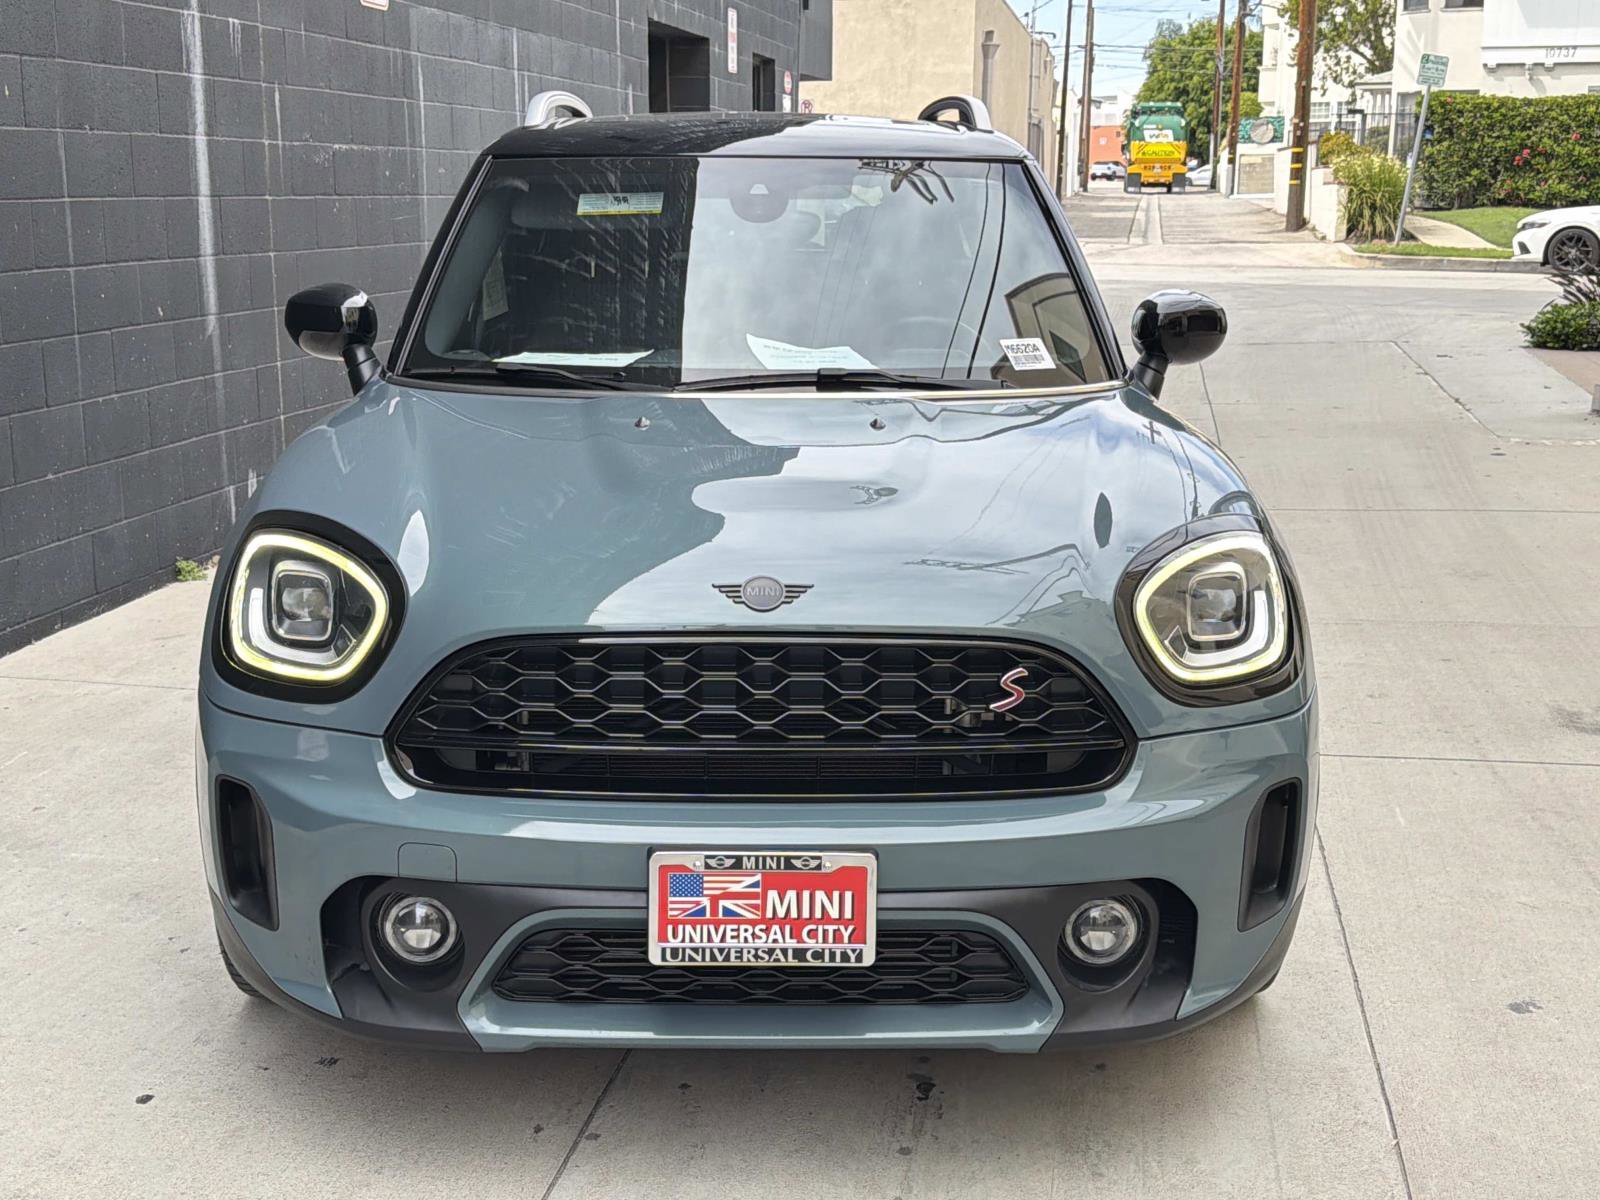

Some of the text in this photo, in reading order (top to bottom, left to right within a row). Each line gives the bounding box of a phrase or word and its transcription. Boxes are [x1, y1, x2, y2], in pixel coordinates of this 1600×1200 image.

[1545, 46, 1577, 58] 10737
[746, 587, 780, 596] MINI
[990, 667, 1028, 712] S
[742, 856, 785, 870] MINI
[765, 889, 854, 920] MINI
[667, 924, 855, 944] UNIVERSAL CITY
[665, 948, 863, 963] UNIVERSAL CITY
